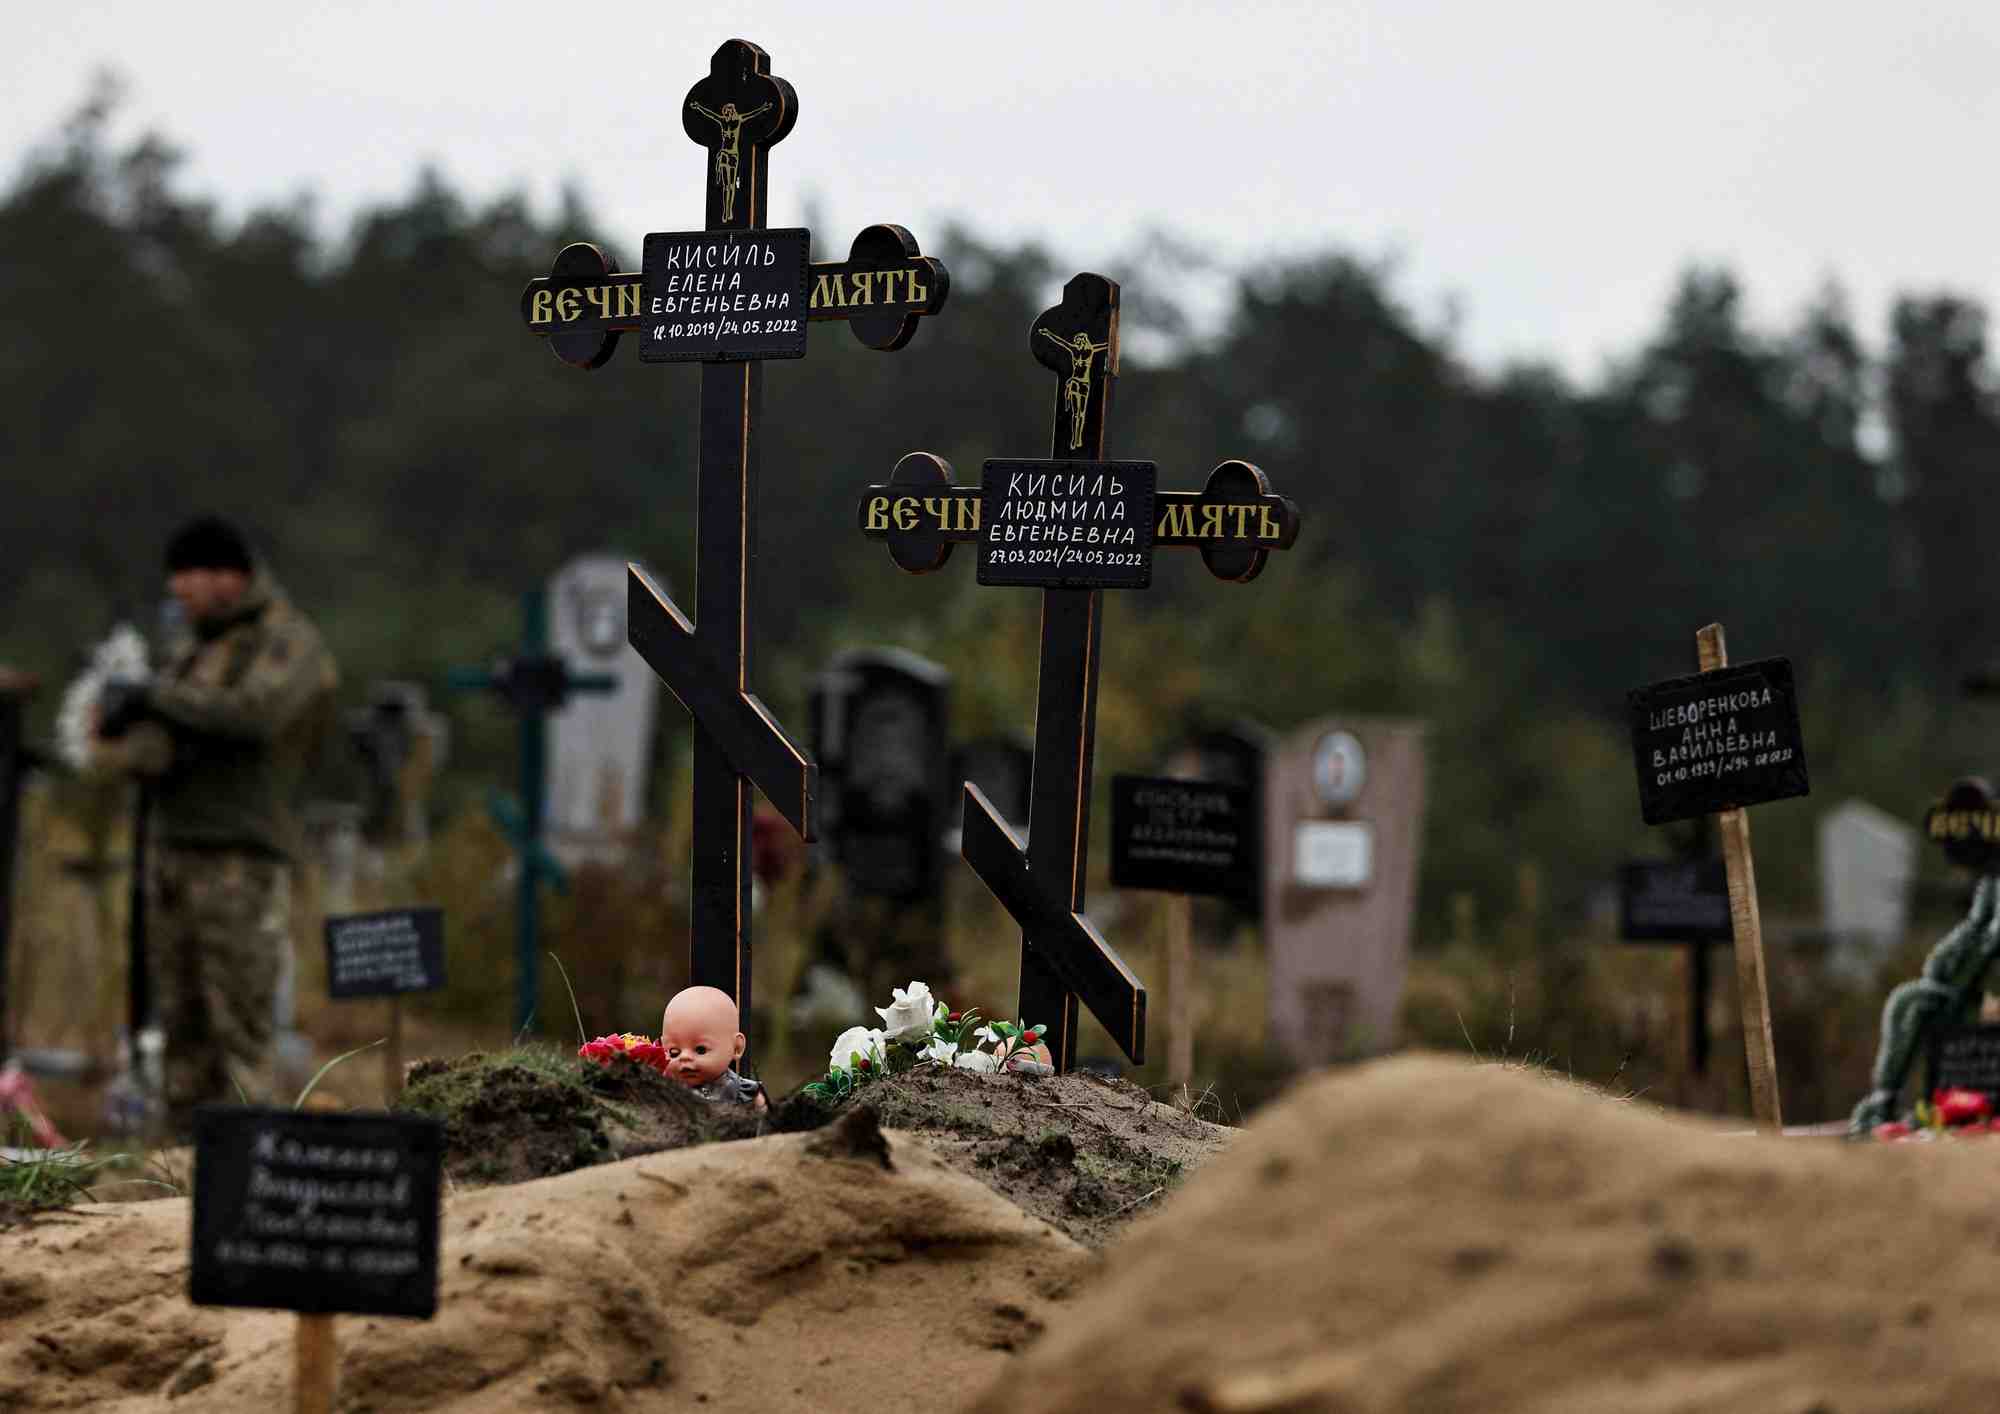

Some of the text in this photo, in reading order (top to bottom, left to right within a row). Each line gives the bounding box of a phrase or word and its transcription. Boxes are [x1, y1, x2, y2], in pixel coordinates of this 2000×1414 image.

[667, 244, 776, 270] КИСИЛЬ
[668, 272, 741, 293] ЕЛЕНА
[529, 269, 928, 324] ВЕЧН МЯТЬ
[651, 292, 790, 314] ЕВГЕНЬЕВНА
[1008, 472, 1124, 497] КИСИЛЬ
[864, 496, 1281, 540] ВЕЧН МЯТЬ
[1000, 500, 1126, 522] ЛЮДМИЛА
[989, 524, 1136, 545] ЕВГЕНЬЕВНА
[1682, 717, 1738, 745] АННА
[1653, 730, 1777, 767] ВАСИЛЬЕВНА
